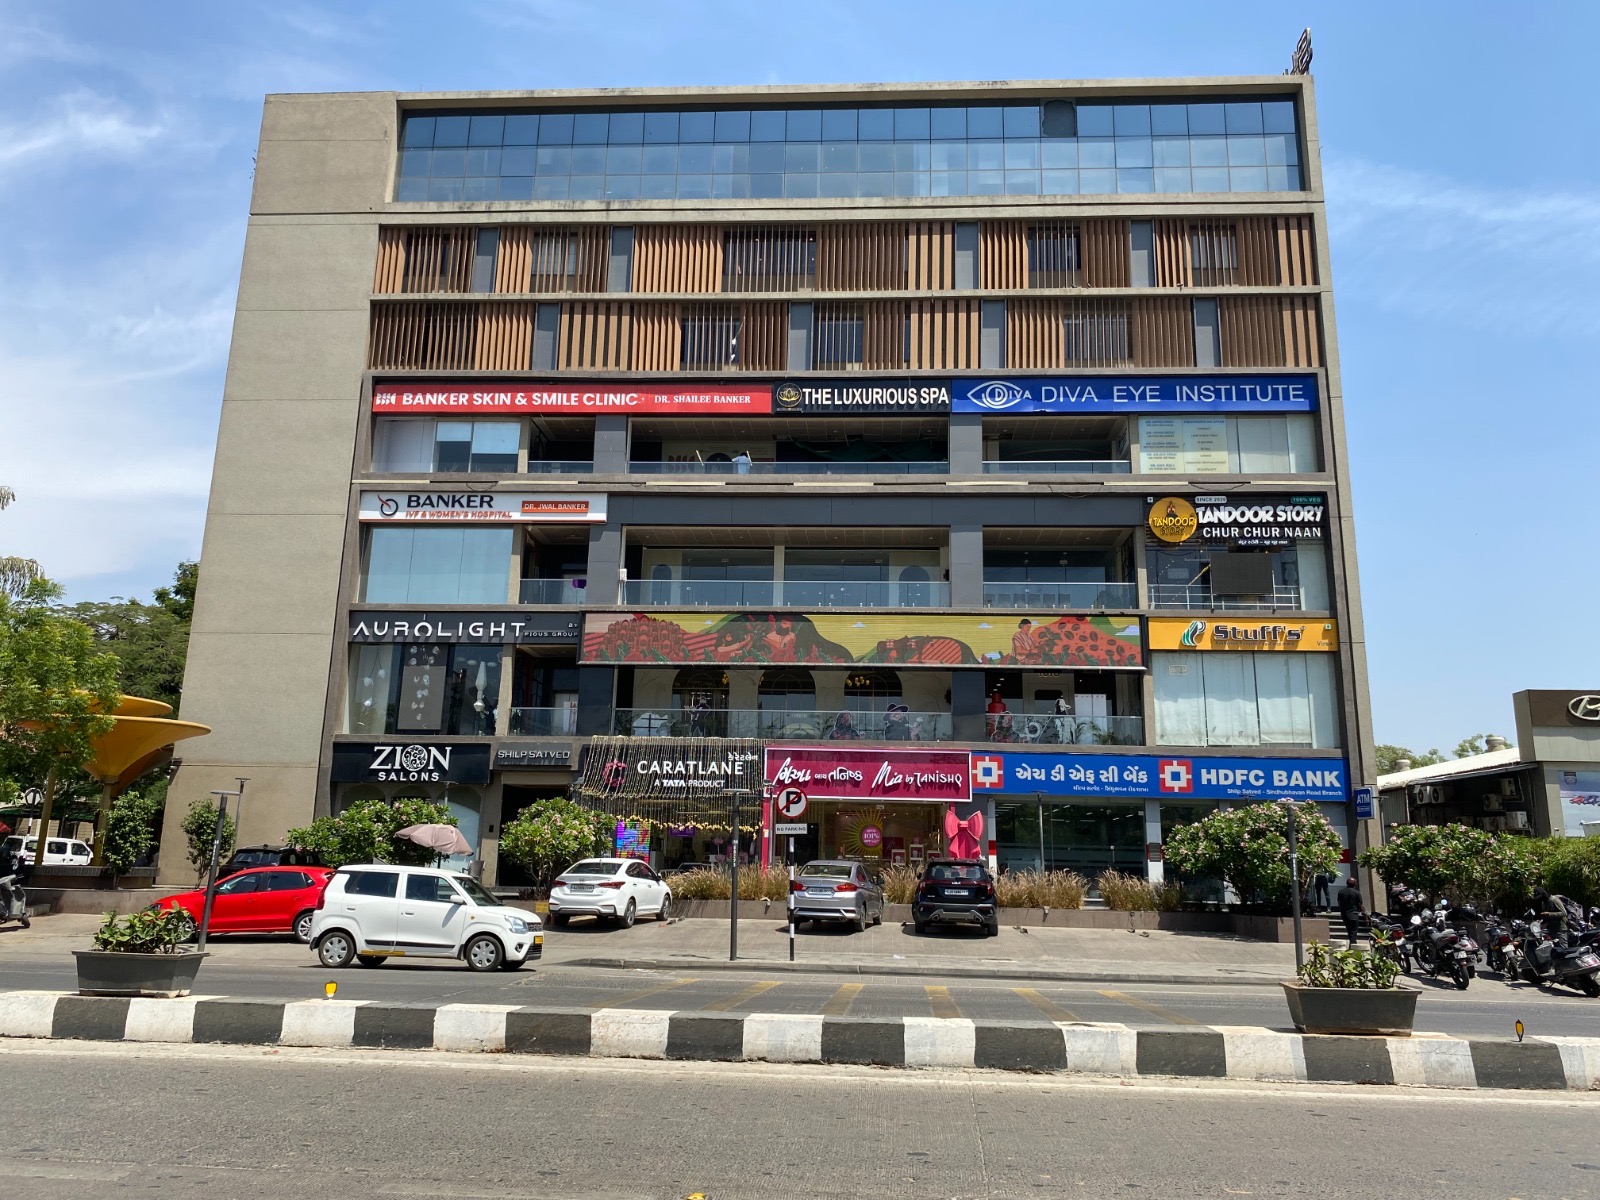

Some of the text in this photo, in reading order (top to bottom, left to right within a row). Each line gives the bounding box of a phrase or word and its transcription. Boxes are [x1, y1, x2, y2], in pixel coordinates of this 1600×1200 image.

[402, 392, 469, 406] BANKER
[472, 392, 511, 406] SKIN
[514, 392, 528, 406] &
[531, 392, 579, 406] SMILE
[582, 392, 639, 406] CLINIC
[654, 395, 751, 404] DR. SHAILEE BANKER
[803, 387, 949, 405] THE LUXURIOUS SPA
[1041, 384, 1305, 403] DIVA EYE INSTITUTE
[407, 494, 494, 509] BANKER
[405, 510, 512, 519] IVF & WOMEN'S HOSPITAL
[1153, 516, 1195, 526] TANDOOR
[1195, 505, 1323, 524] TANDOOR STORY
[1202, 527, 1322, 538] CHUR CHUR NAAN
[352, 619, 526, 637] AUROLIGHT
[1213, 625, 1301, 641] Stuff's
[369, 745, 452, 771] ZION
[497, 750, 571, 759] SHILP SATVED
[637, 760, 744, 775] CARATLANE
[871, 761, 902, 788] Mia
[905, 773, 914, 785] by
[1015, 763, 1148, 784] એચ ડી એફ સી બેંક
[378, 772, 440, 781] SALONS
[662, 779, 686, 787] TATA
[688, 780, 725, 788] PRODUCT
[1200, 768, 1342, 788] HDFC BANK
[1322, 789, 1343, 797] Branch
[1356, 793, 1370, 804] ATM
